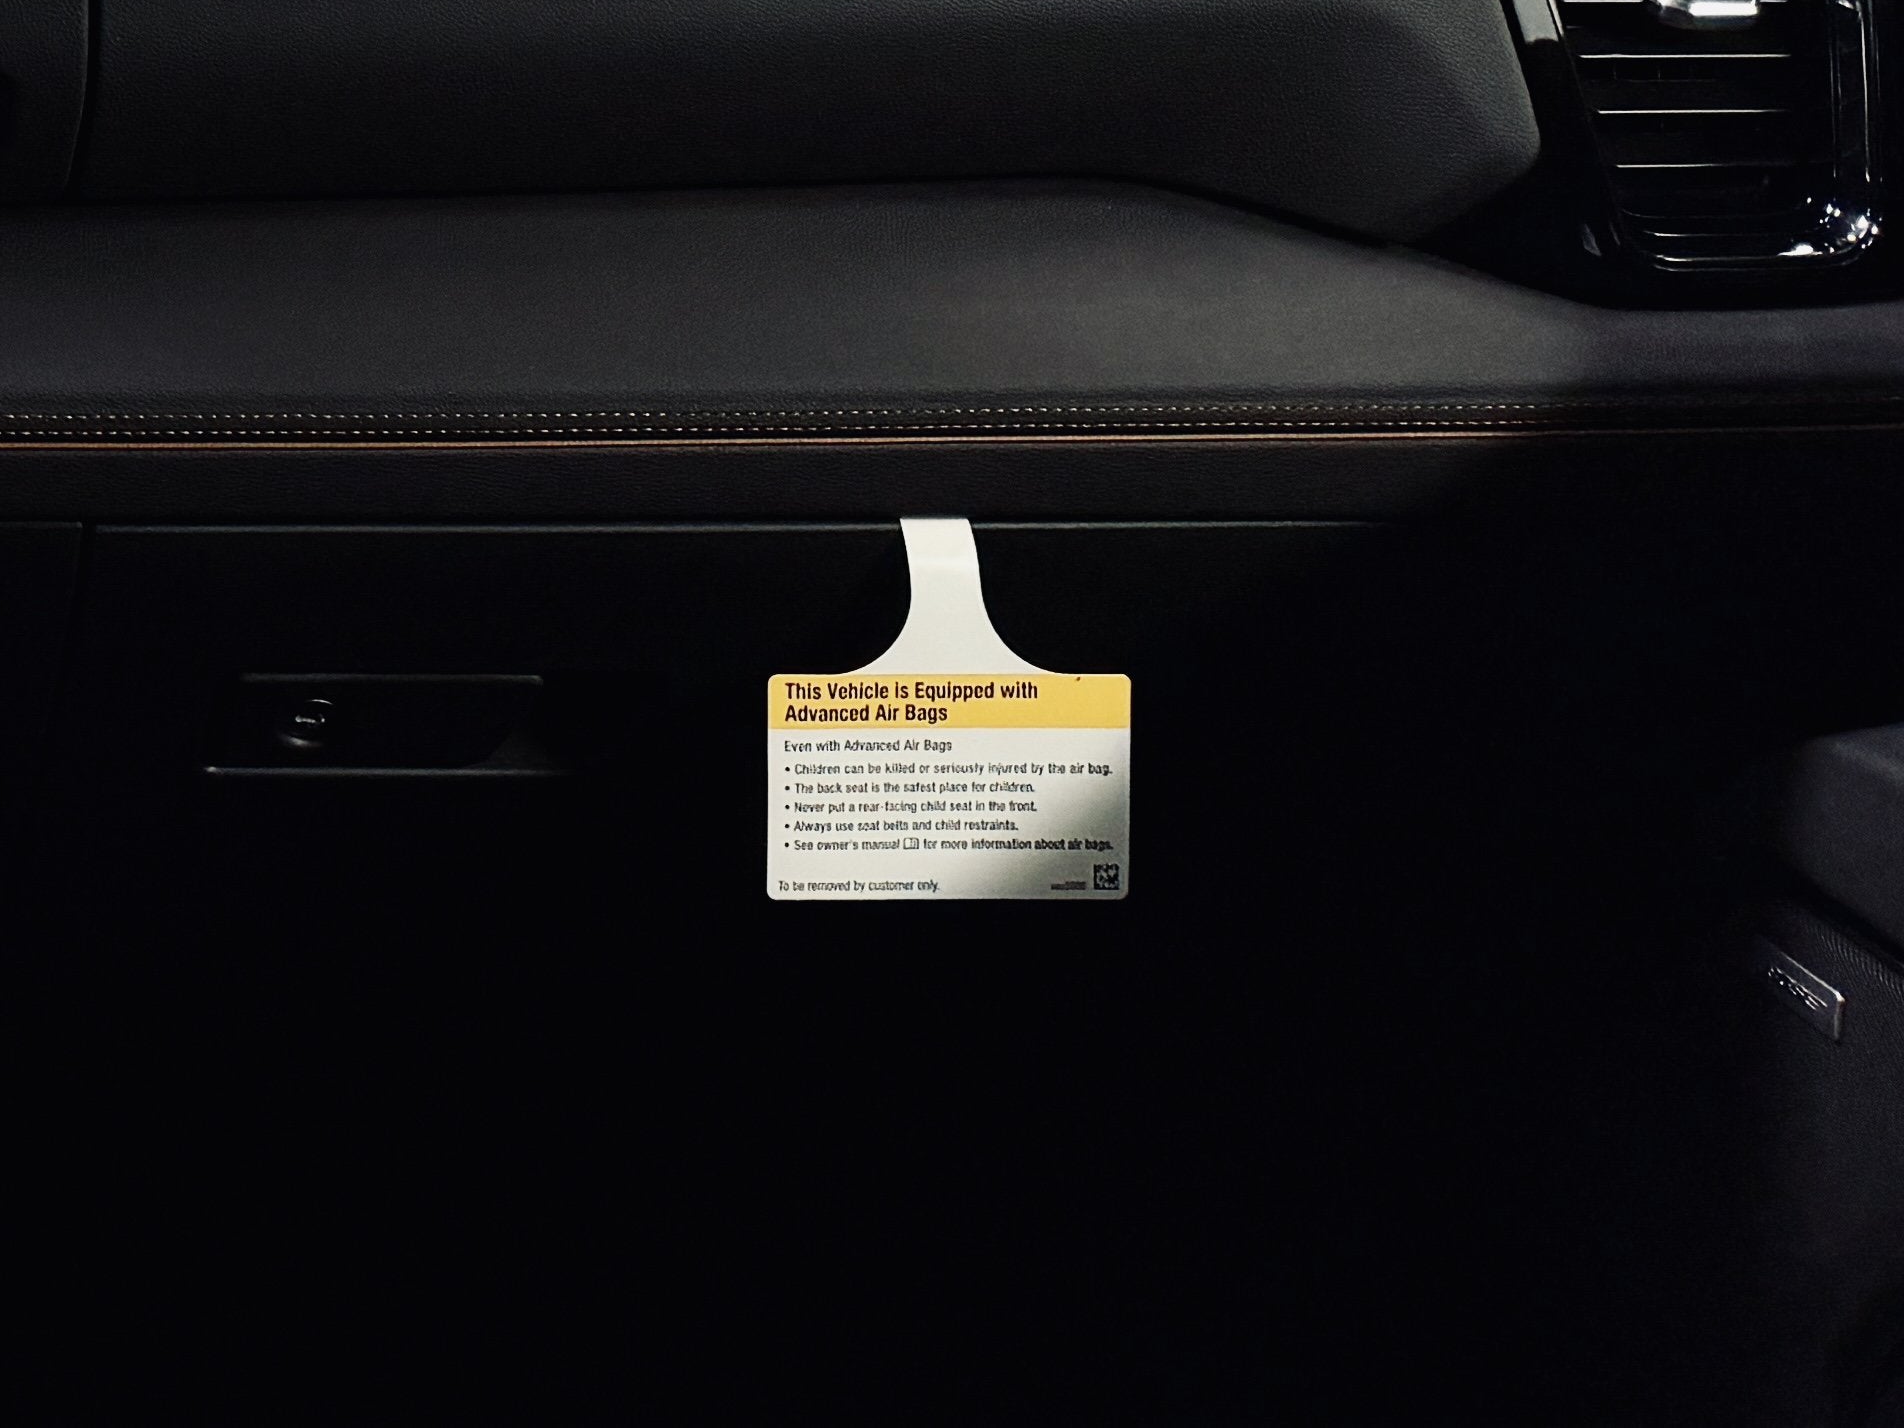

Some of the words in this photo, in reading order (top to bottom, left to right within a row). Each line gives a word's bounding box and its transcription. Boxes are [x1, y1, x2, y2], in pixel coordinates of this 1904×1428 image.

[785, 682, 821, 700] This
[827, 682, 889, 700] Vehicle
[895, 682, 909, 700] is
[914, 681, 994, 705] Equipped
[1000, 681, 1038, 700] with
[784, 704, 869, 723] Advanced
[875, 704, 900, 722] Air
[905, 704, 948, 725] Bags
[784, 740, 813, 753] Even
[815, 739, 841, 752] with
[843, 739, 901, 752] Advanced
[903, 738, 920, 752] Air
[923, 739, 953, 754] Bags
[794, 763, 841, 776] Children
[844, 765, 865, 775] can
[867, 762, 882, 775] be
[884, 762, 916, 775] killed
[918, 764, 931, 775] or
[933, 761, 985, 776] seriously
[988, 762, 1028, 776] injured
[1030, 762, 1045, 777] by
[1047, 762, 1067, 775] the
[1069, 761, 1085, 775] air
[1087, 762, 1114, 777] bag.
[794, 782, 814, 795] The
[816, 781, 843, 794] back
[845, 782, 869, 794] seat
[871, 781, 881, 794] is
[883, 781, 901, 793] the
[903, 781, 936, 793] safest
[938, 781, 968, 795] place
[971, 781, 987, 793] for
[988, 780, 1036, 793] children.
[794, 801, 826, 813] Never
[828, 801, 846, 815] put
[848, 803, 856, 813] a
[858, 800, 918, 814] rear-facing
[920, 800, 947, 812] child
[949, 800, 973, 812] seat
[975, 800, 986, 812] in
[988, 800, 1007, 813] the
[1008, 799, 1038, 813] front.
[793, 820, 832, 834] Always
[835, 822, 855, 832] use
[856, 819, 880, 832] seat
[882, 819, 909, 832] belts
[911, 819, 933, 831] and
[934, 818, 961, 831] child
[963, 818, 1020, 832] restraints.
[793, 839, 814, 851] See
[816, 839, 859, 851] owner's
[861, 838, 901, 851] manual
[922, 837, 938, 850] for
[940, 840, 969, 851] more
[971, 838, 1033, 851] information
[1034, 838, 1066, 851] about
[1067, 837, 1083, 851] air
[1084, 838, 1115, 853] bags.
[778, 880, 790, 892] To
[792, 880, 805, 892] be
[807, 880, 851, 892] removed
[852, 879, 866, 893] by
[868, 880, 915, 892] customer
[916, 878, 940, 894] only.
